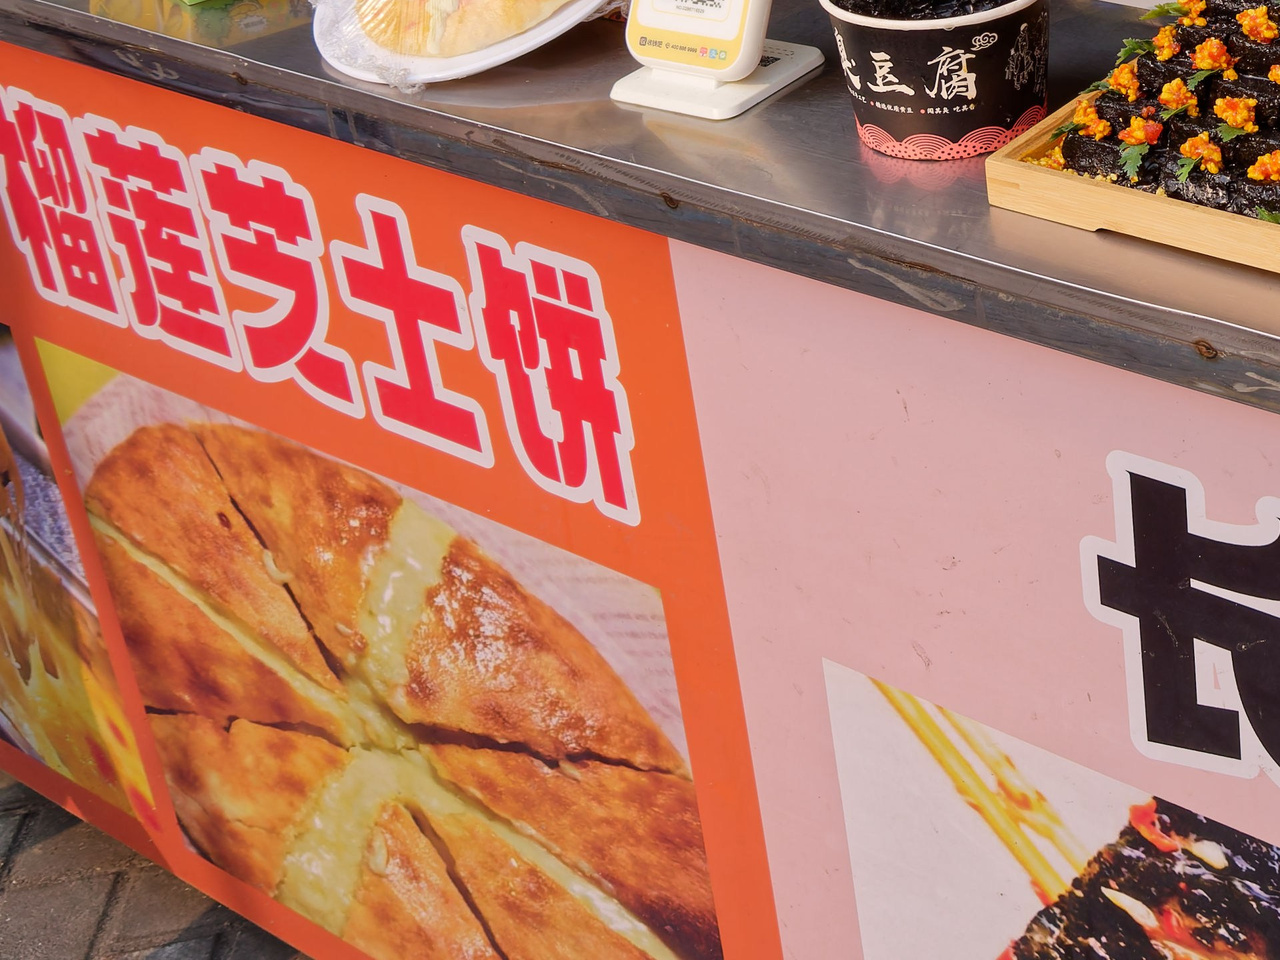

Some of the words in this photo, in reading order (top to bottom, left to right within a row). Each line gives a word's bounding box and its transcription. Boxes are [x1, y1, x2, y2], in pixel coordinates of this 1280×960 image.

[834, 27, 977, 100] 臭豆腐
[927, 107, 950, 115] 闻其臭
[953, 103, 976, 113] 吃其香
[0, 96, 632, 516] 榴莲芝士饼
